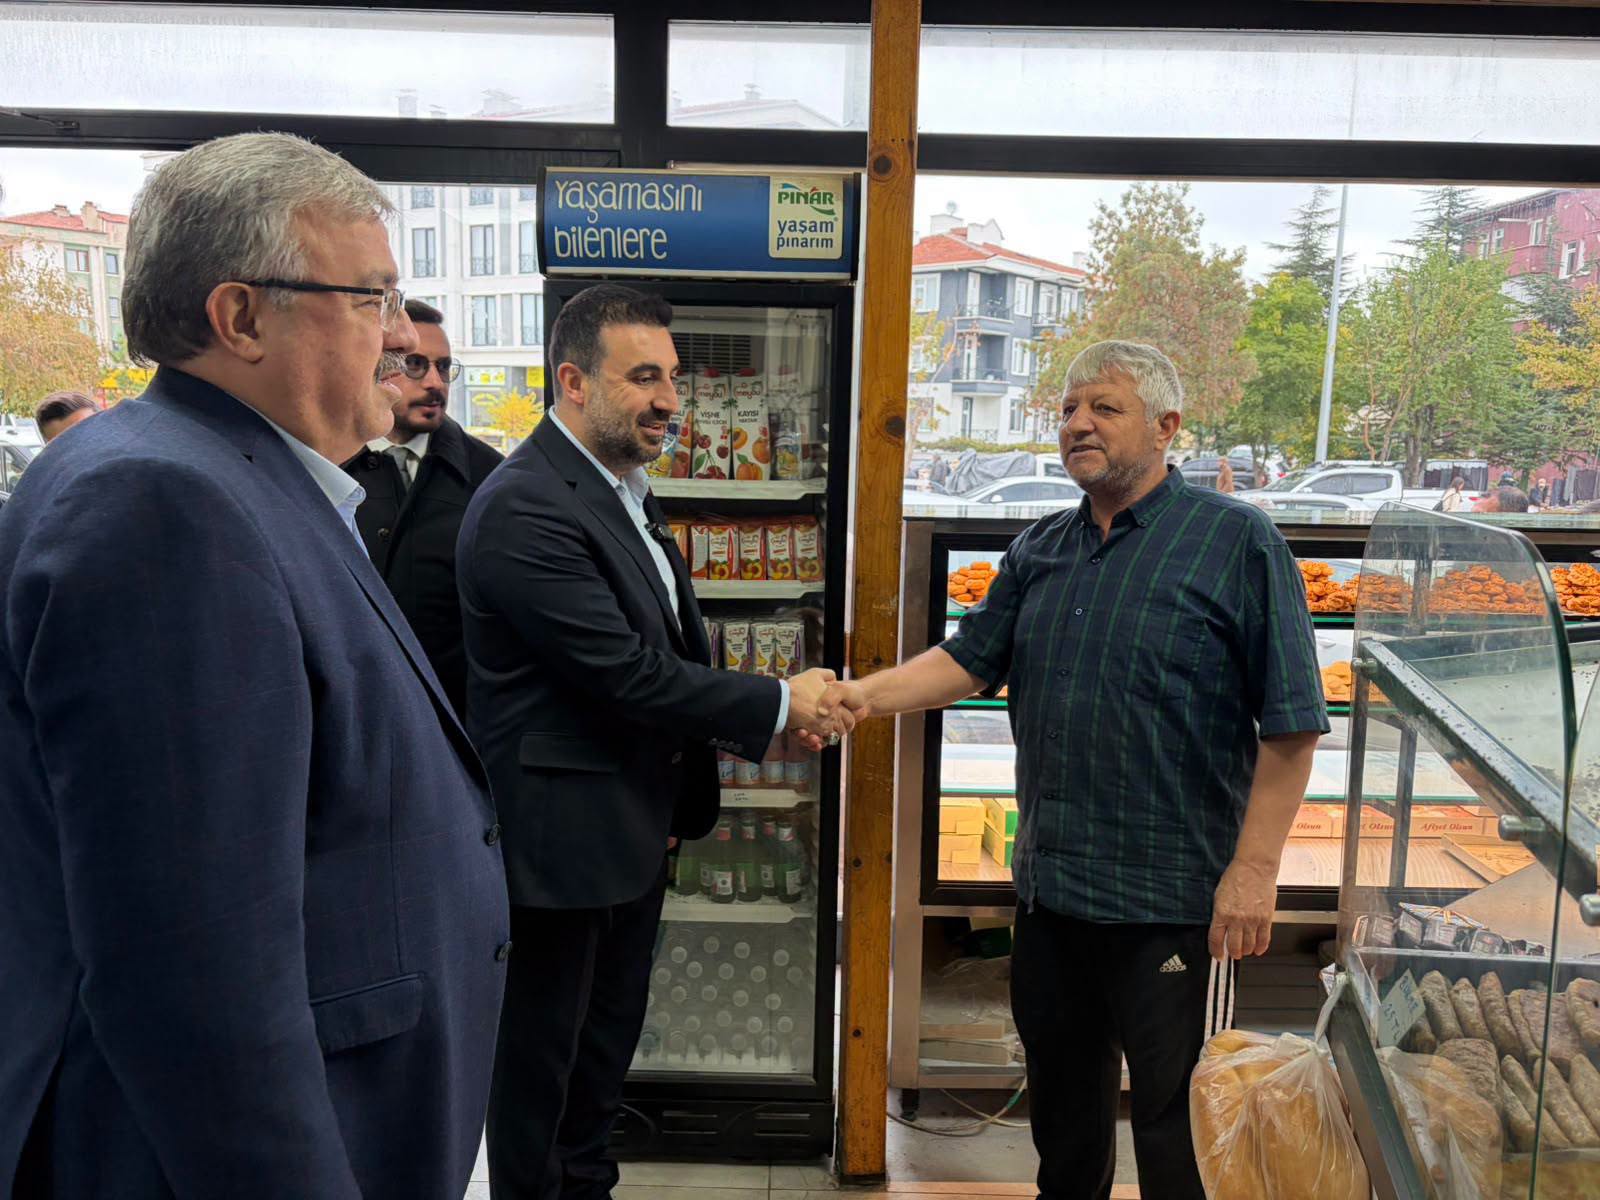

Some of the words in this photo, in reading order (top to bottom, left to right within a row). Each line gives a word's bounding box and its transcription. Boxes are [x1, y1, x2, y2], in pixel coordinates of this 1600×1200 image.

[555, 180, 702, 224] Yaşamasını
[777, 191, 834, 205] PINAR
[777, 220, 834, 236] yaşam
[554, 225, 668, 260] bilenlere
[776, 236, 834, 251] pınarım
[1421, 822, 1447, 831] Afiyet
[1449, 823, 1473, 831] Olsun
